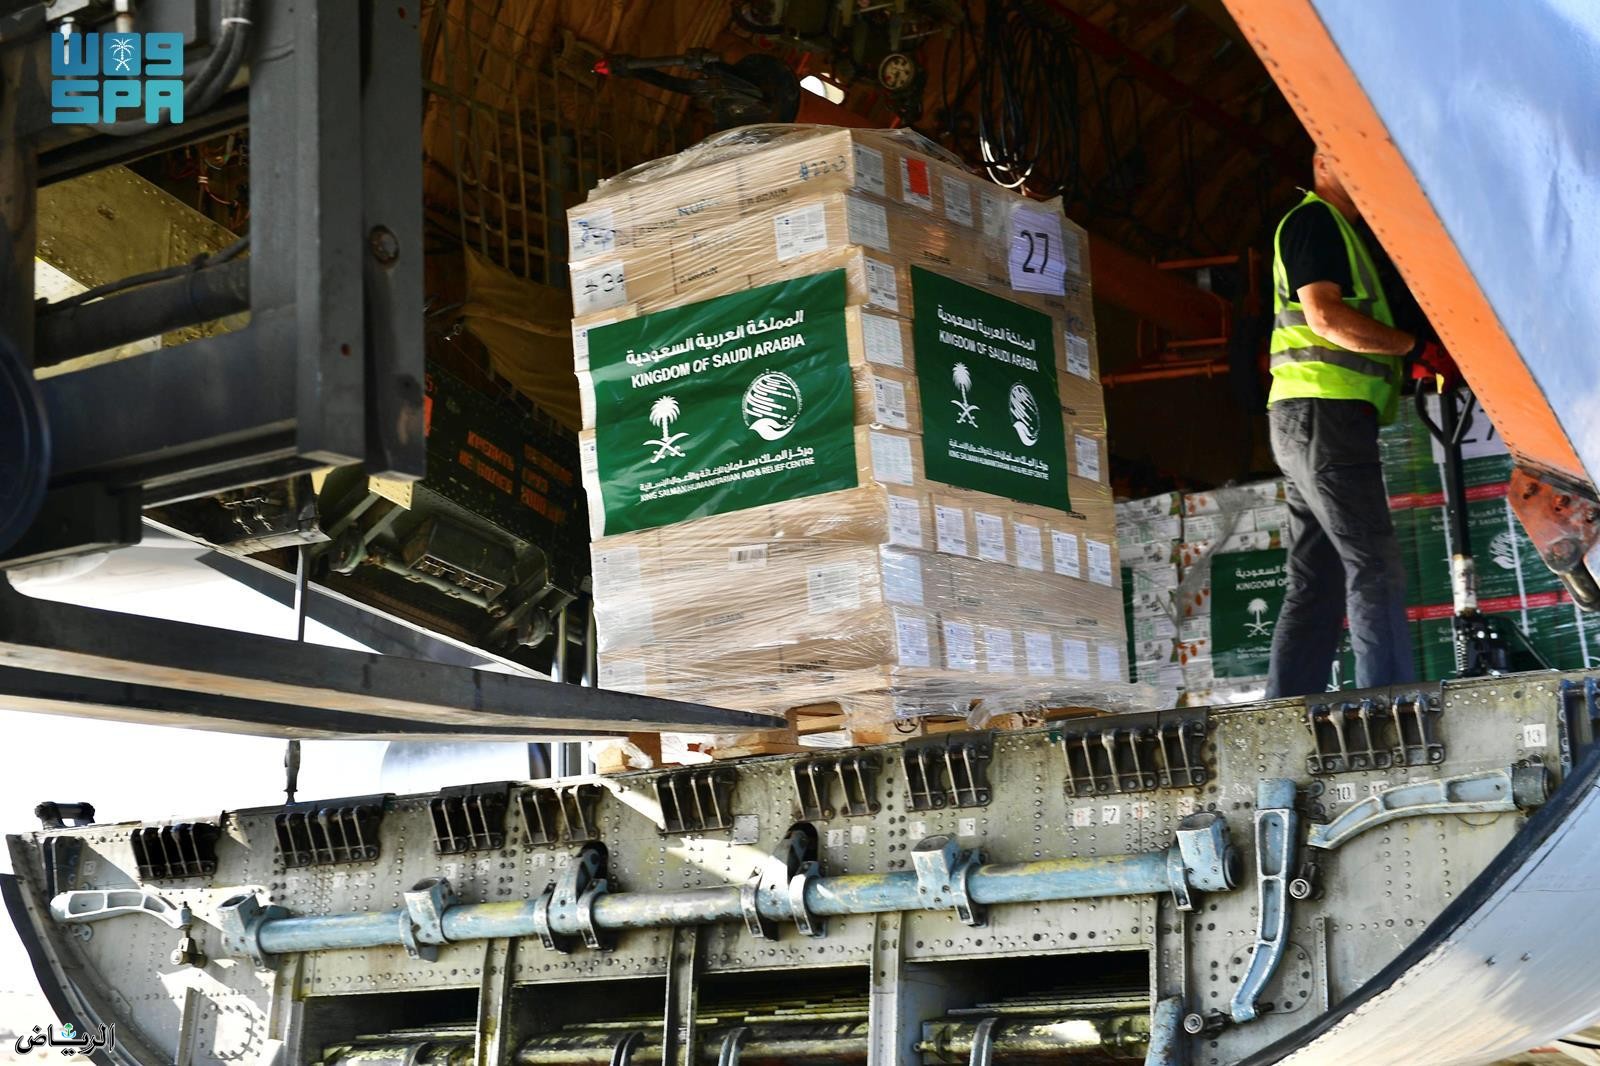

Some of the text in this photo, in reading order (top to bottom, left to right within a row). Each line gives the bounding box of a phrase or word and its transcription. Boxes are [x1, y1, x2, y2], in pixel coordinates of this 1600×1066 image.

[1020, 230, 1049, 274] 27
[626, 309, 804, 367] المملكة العربية السعودية
[938, 304, 1036, 351] المملكة العربية السعودية
[631, 333, 805, 388] KINGDOM OF SAUDI ARABIA
[939, 330, 1038, 373] KINGDOM OF SAUDI ARABIA
[785, 456, 815, 469] CENTRE
[788, 447, 814, 460] مركز
[1235, 565, 1281, 579] السعودية
[1235, 579, 1276, 591] KINGDOM
[560, 855, 567, 867] 2
